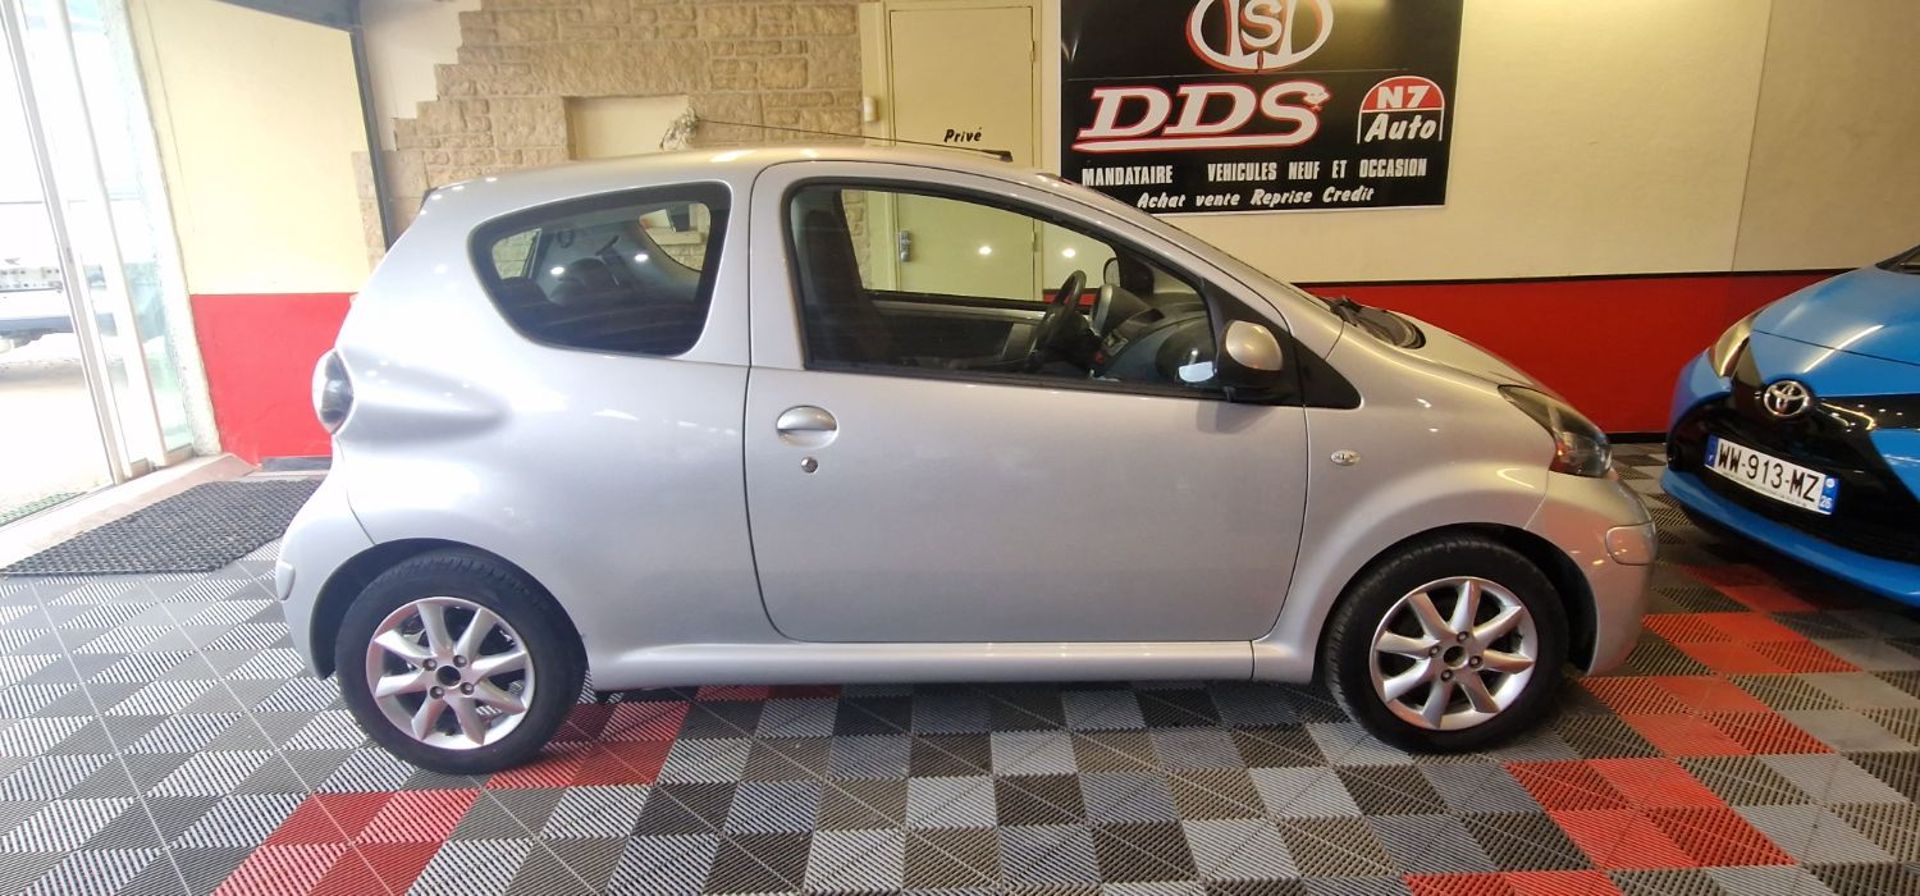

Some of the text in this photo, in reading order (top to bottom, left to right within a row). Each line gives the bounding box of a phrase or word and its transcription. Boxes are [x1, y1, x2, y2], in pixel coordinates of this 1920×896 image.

[1377, 85, 1431, 109] N7
[1072, 81, 1331, 152] DDS
[1365, 113, 1437, 142] Auto
[943, 126, 983, 143] Privé
[1082, 158, 1427, 187] MANDATAIRE VEHICULES NEUF ET OCCASION
[1137, 185, 1374, 209] Achat vente Reprise Credit
[1718, 443, 1820, 503] WW-913-MZ
